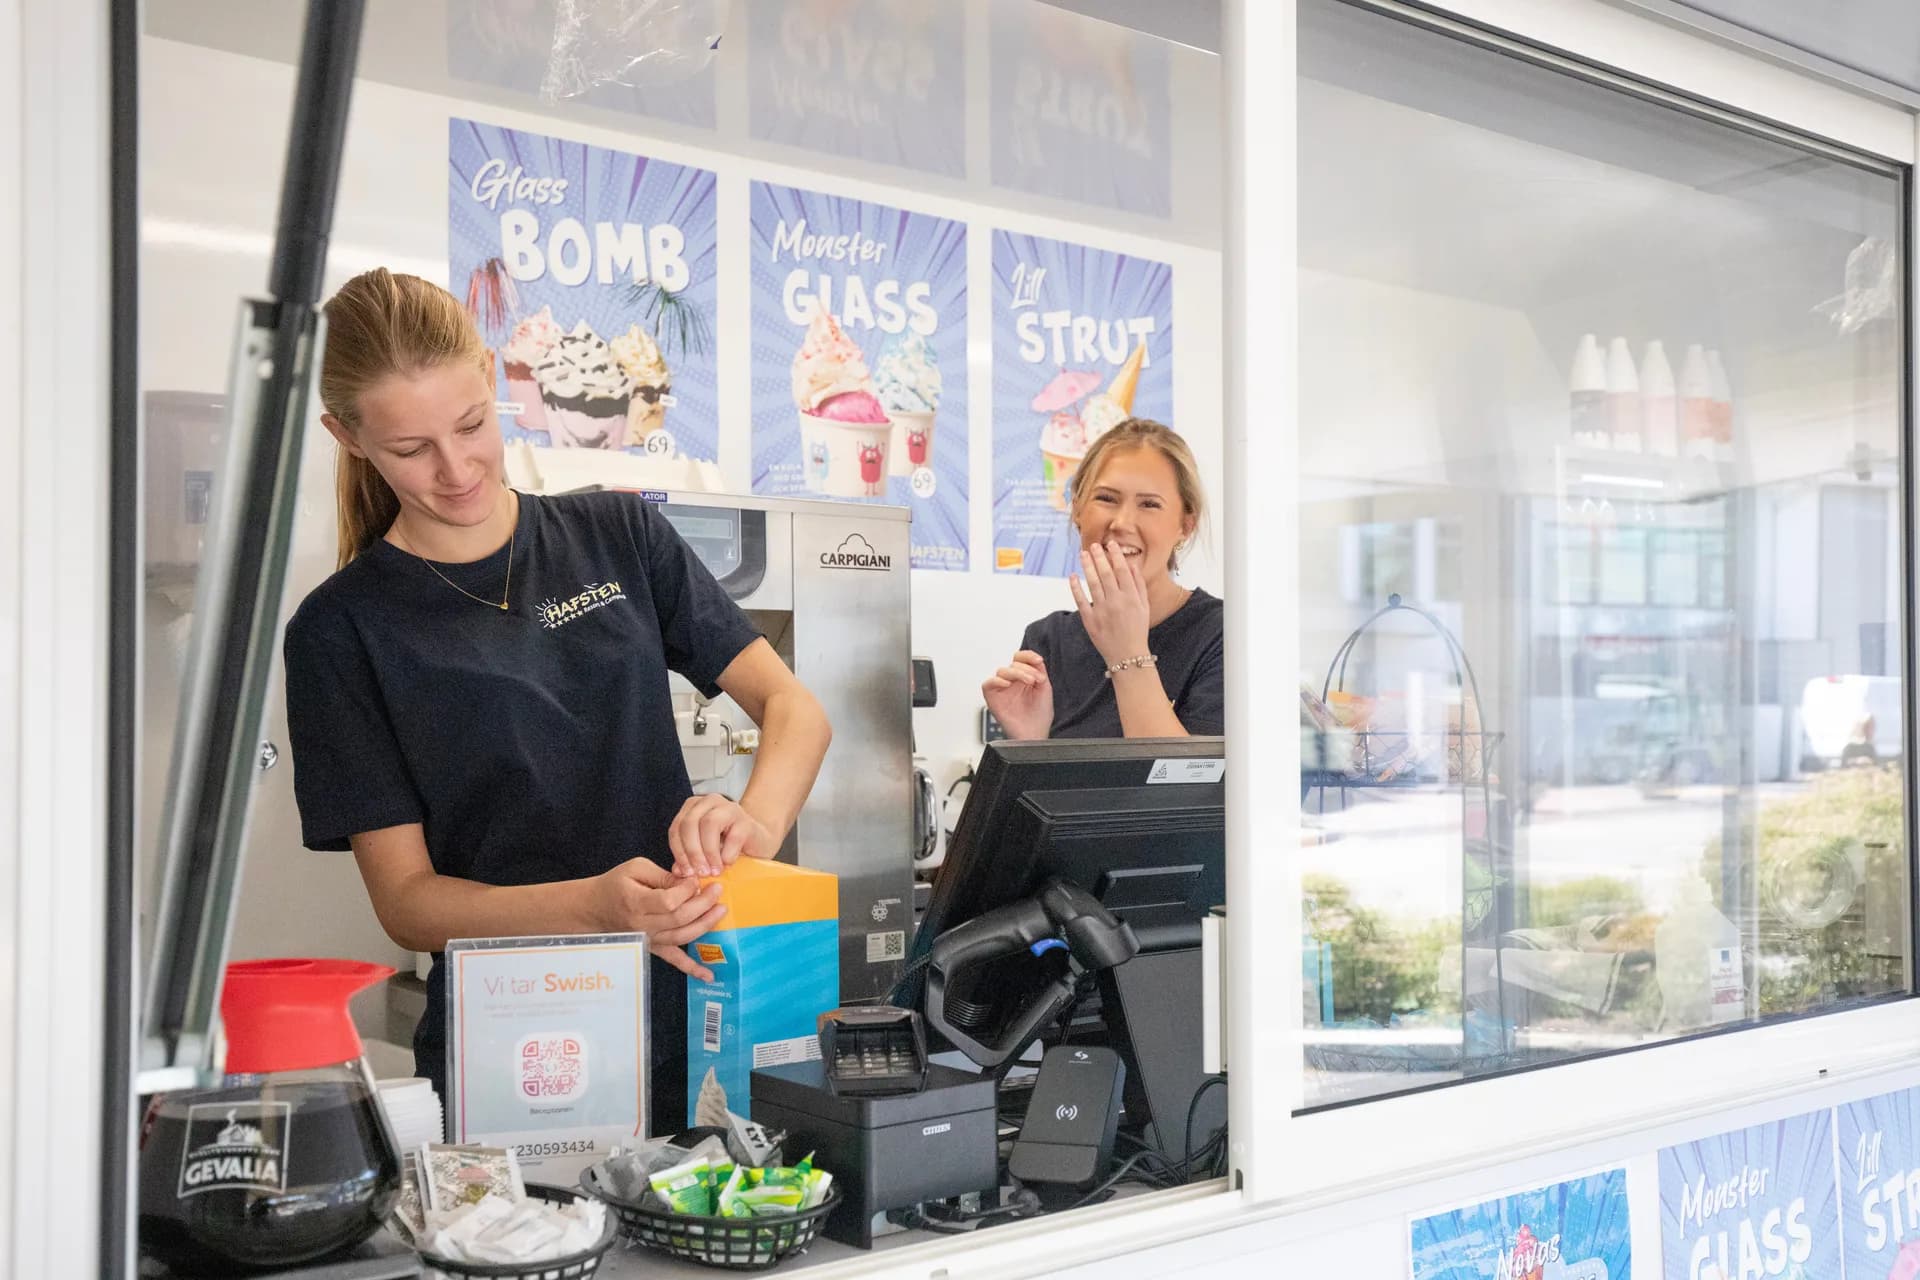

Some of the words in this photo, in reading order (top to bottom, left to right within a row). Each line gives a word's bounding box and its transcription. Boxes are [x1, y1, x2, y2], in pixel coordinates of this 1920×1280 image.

[471, 158, 568, 210] Glass
[500, 208, 690, 293] BOMB
[771, 218, 887, 265] Monster
[783, 268, 938, 336] GLASS
[1010, 262, 1047, 309] Lill
[1016, 310, 1155, 369] STRUT
[647, 436, 668, 454] 69
[913, 470, 932, 490] 69
[820, 552, 891, 568] CARPIGIANI
[546, 581, 622, 621] HAFSTEN
[484, 977, 504, 995] Vi
[511, 976, 537, 994] tar
[544, 971, 614, 993] Swish.
[511, 1140, 595, 1157] 230593434
[922, 1123, 951, 1136] CITIZEN
[185, 1156, 279, 1185] GEVALIA
[1856, 1129, 1882, 1194] Lill
[1680, 1165, 1769, 1240] Monster
[1690, 1197, 1812, 1280] GLASS
